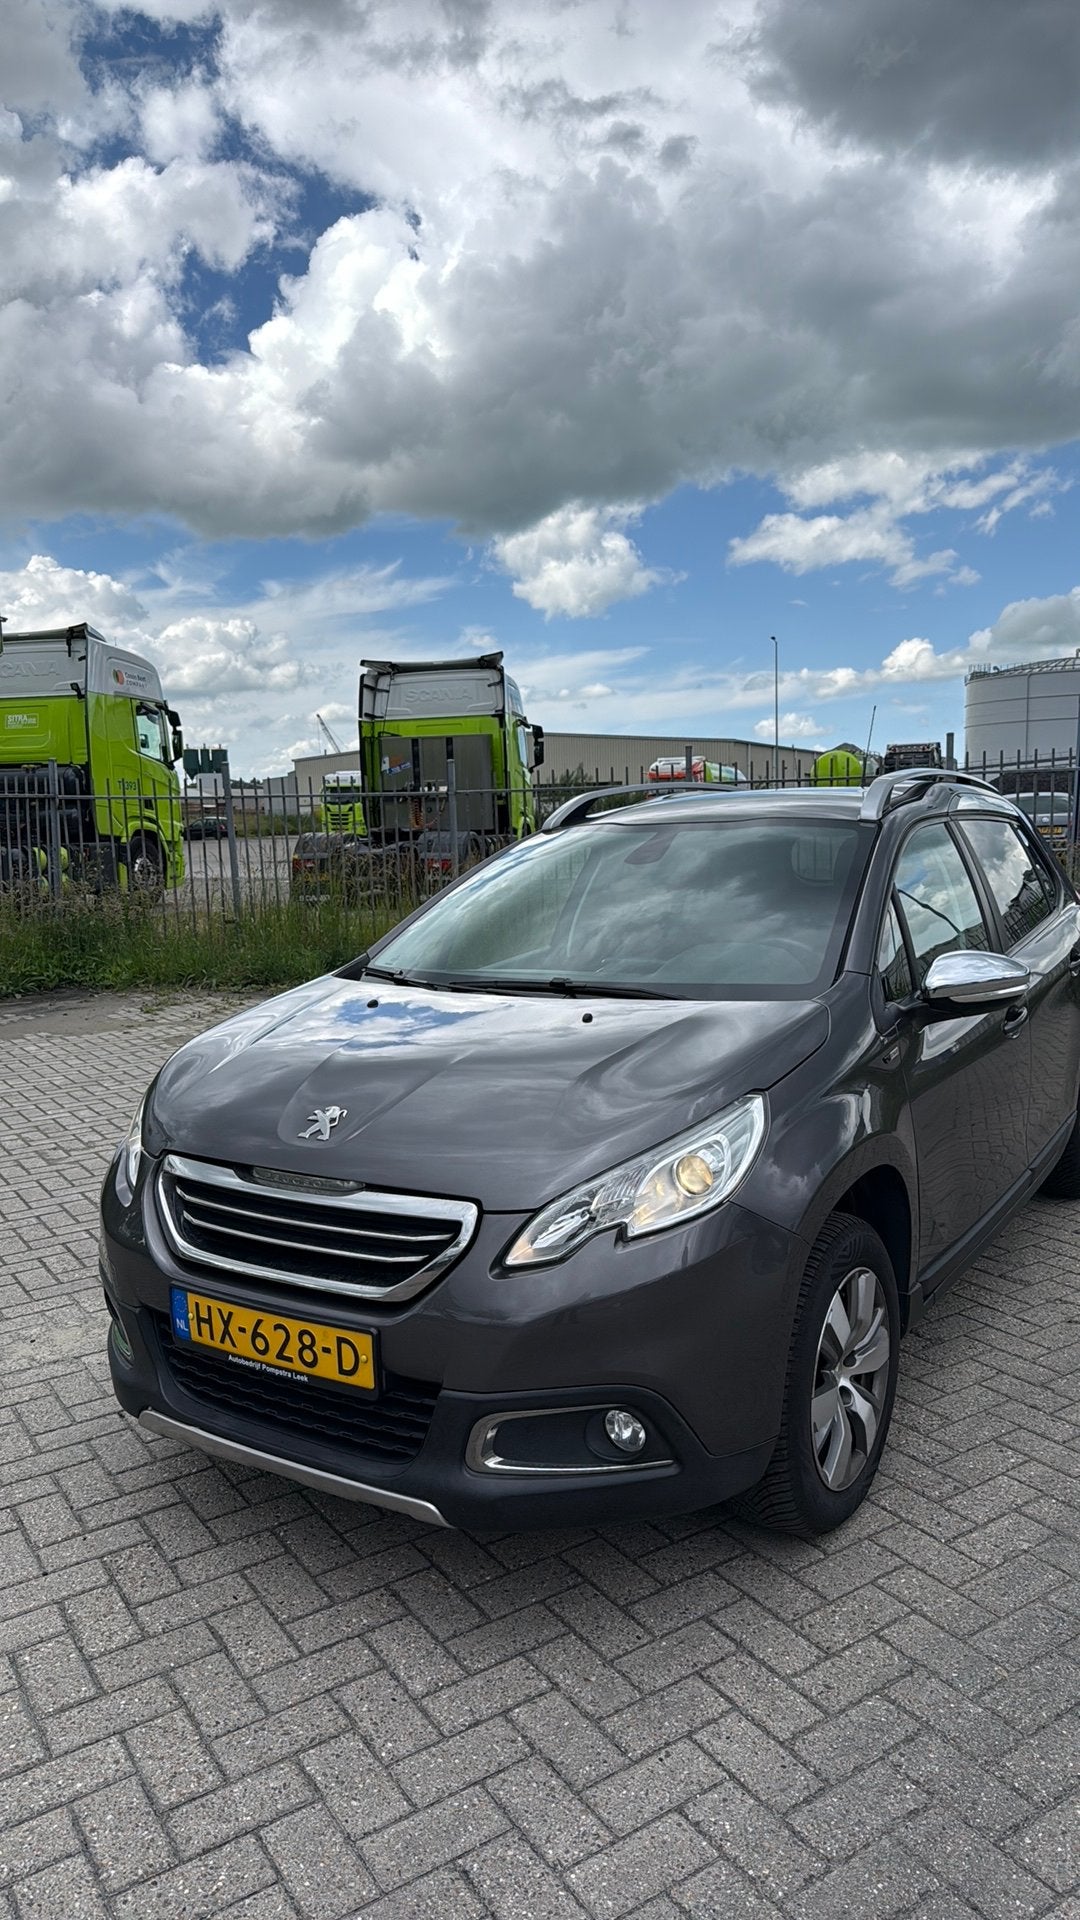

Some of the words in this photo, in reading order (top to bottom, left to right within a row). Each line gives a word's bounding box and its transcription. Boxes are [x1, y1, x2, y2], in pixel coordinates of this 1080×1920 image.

[0, 660, 61, 678] CANIA
[405, 686, 473, 703] SCANIA
[117, 780, 137, 791] T393
[176, 1318, 189, 1332] NL
[195, 1301, 360, 1377] HX-628-D
[228, 1354, 261, 1371] Autobedrijf
[261, 1363, 292, 1378] Pompstra
[292, 1372, 309, 1382] Leek
